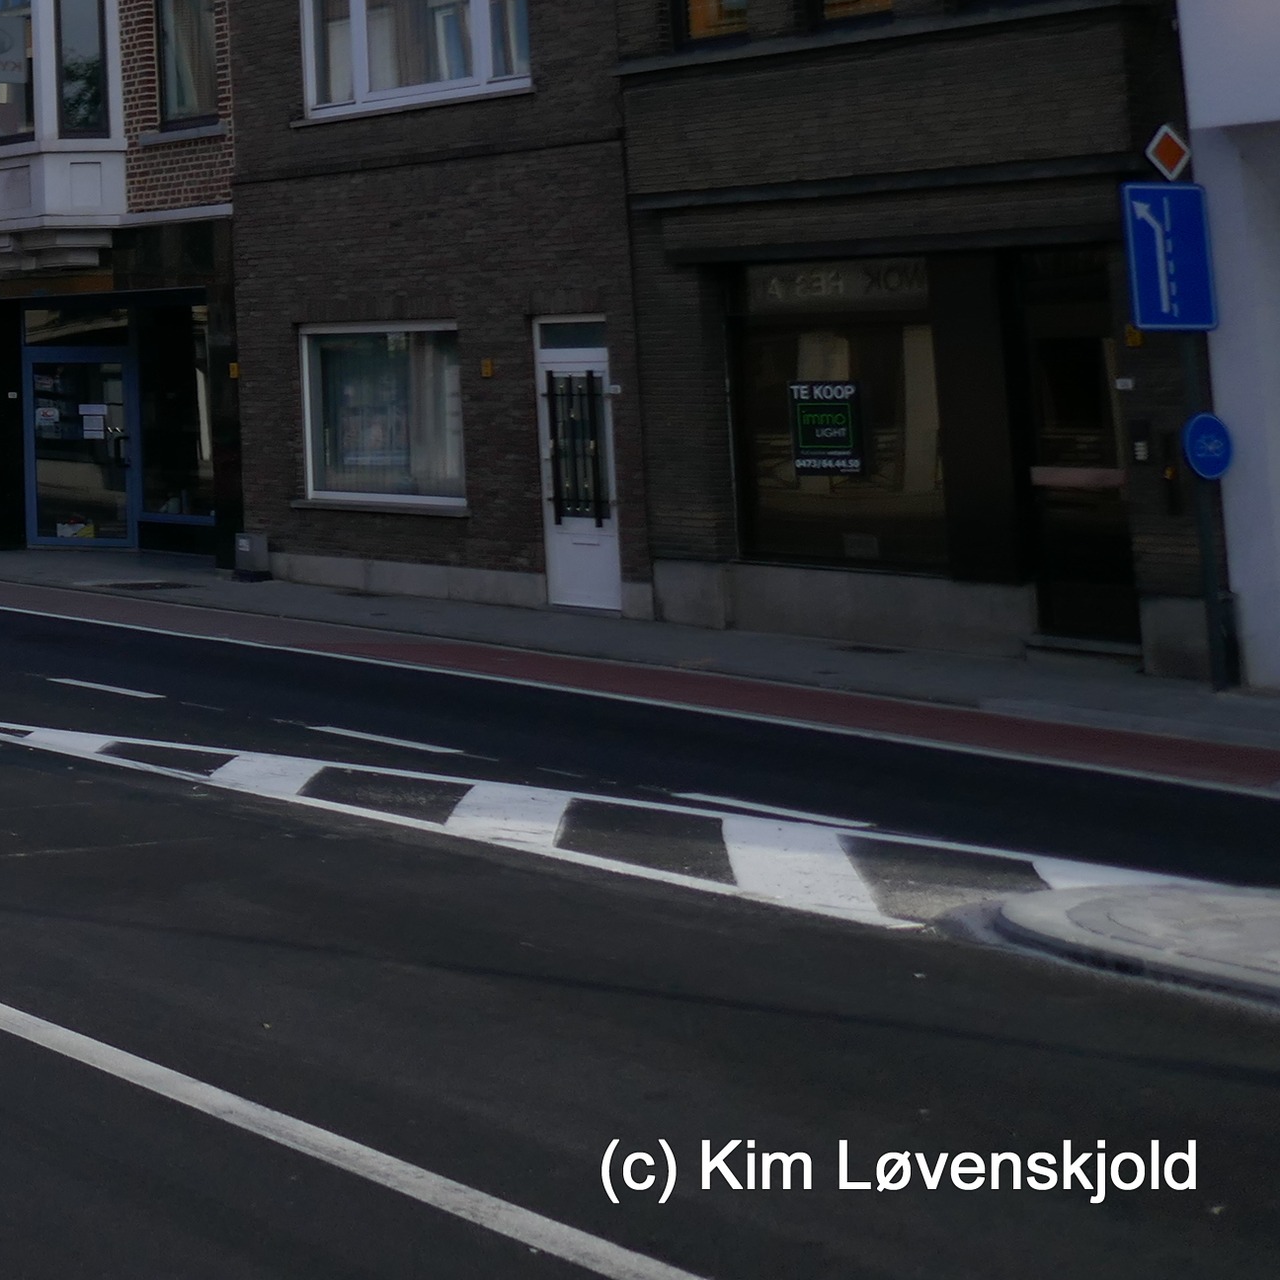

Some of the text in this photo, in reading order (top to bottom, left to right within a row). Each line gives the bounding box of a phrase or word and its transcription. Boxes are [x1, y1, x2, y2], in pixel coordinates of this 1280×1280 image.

[789, 384, 856, 400] TE KOOP
[801, 410, 846, 425] immo
